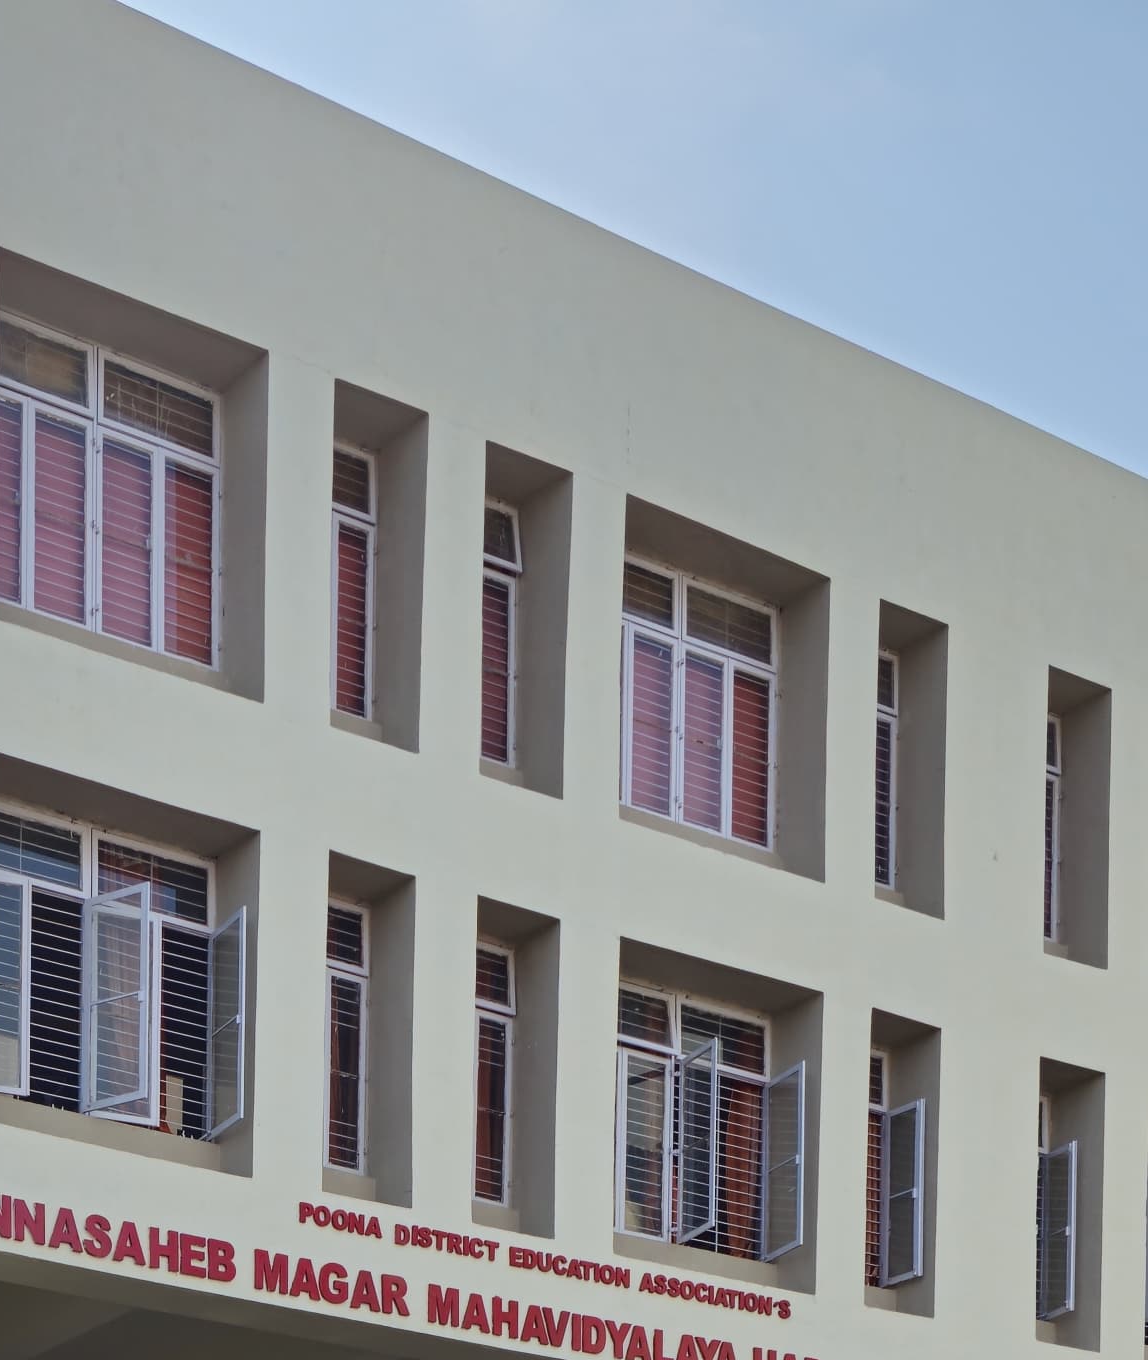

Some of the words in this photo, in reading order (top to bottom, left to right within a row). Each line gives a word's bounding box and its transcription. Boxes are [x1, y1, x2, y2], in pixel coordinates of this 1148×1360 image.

[253, 1248, 411, 1317] MAGAR
[299, 1202, 382, 1239] POONA
[394, 1224, 500, 1261] DISTRICT
[509, 1246, 631, 1288] EDUCATION
[639, 1273, 792, 1319] ASSOCIATION'S
